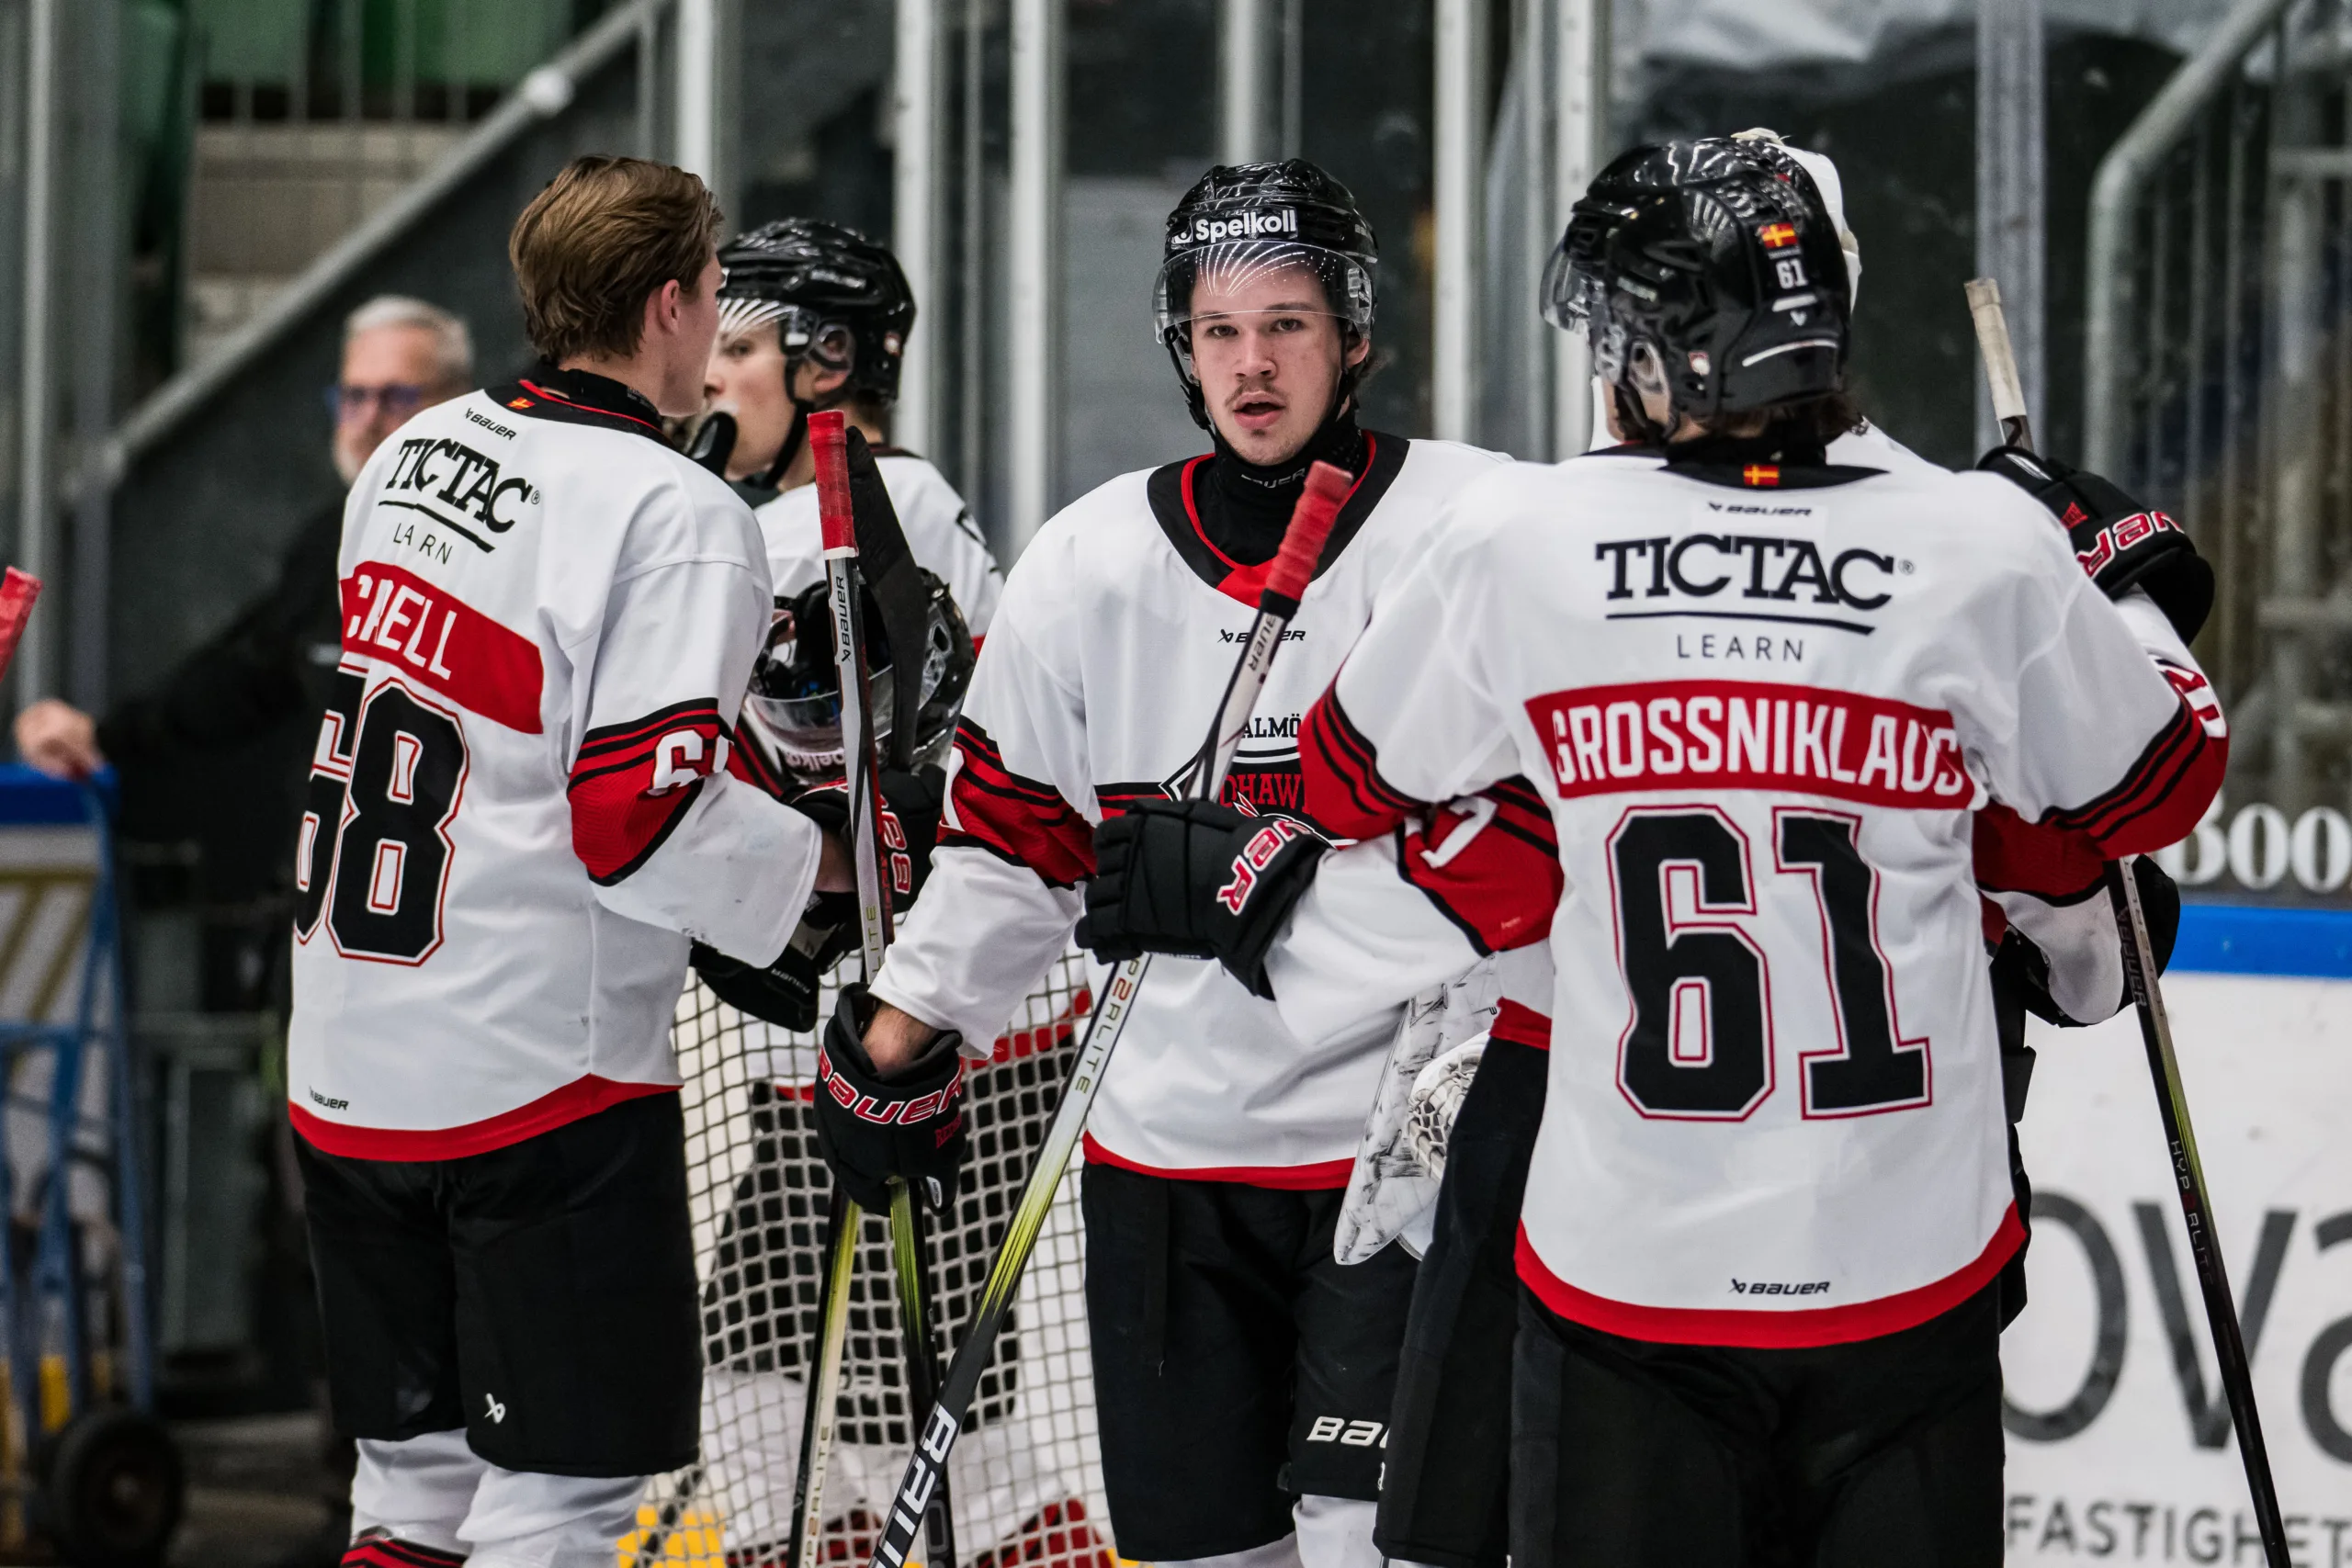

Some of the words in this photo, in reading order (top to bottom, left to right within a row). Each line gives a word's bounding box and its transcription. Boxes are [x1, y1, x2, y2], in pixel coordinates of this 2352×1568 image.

[1196, 209, 1296, 243] Spelkoll
[1776, 258, 1808, 288] 61
[471, 413, 516, 440] BAUER
[836, 576, 851, 646] BAUER
[1677, 635, 1804, 662] LEARN
[1240, 714, 1301, 739] ALMÖ
[1605, 804, 1933, 1122] 61
[1748, 1281, 1830, 1295] BAUER
